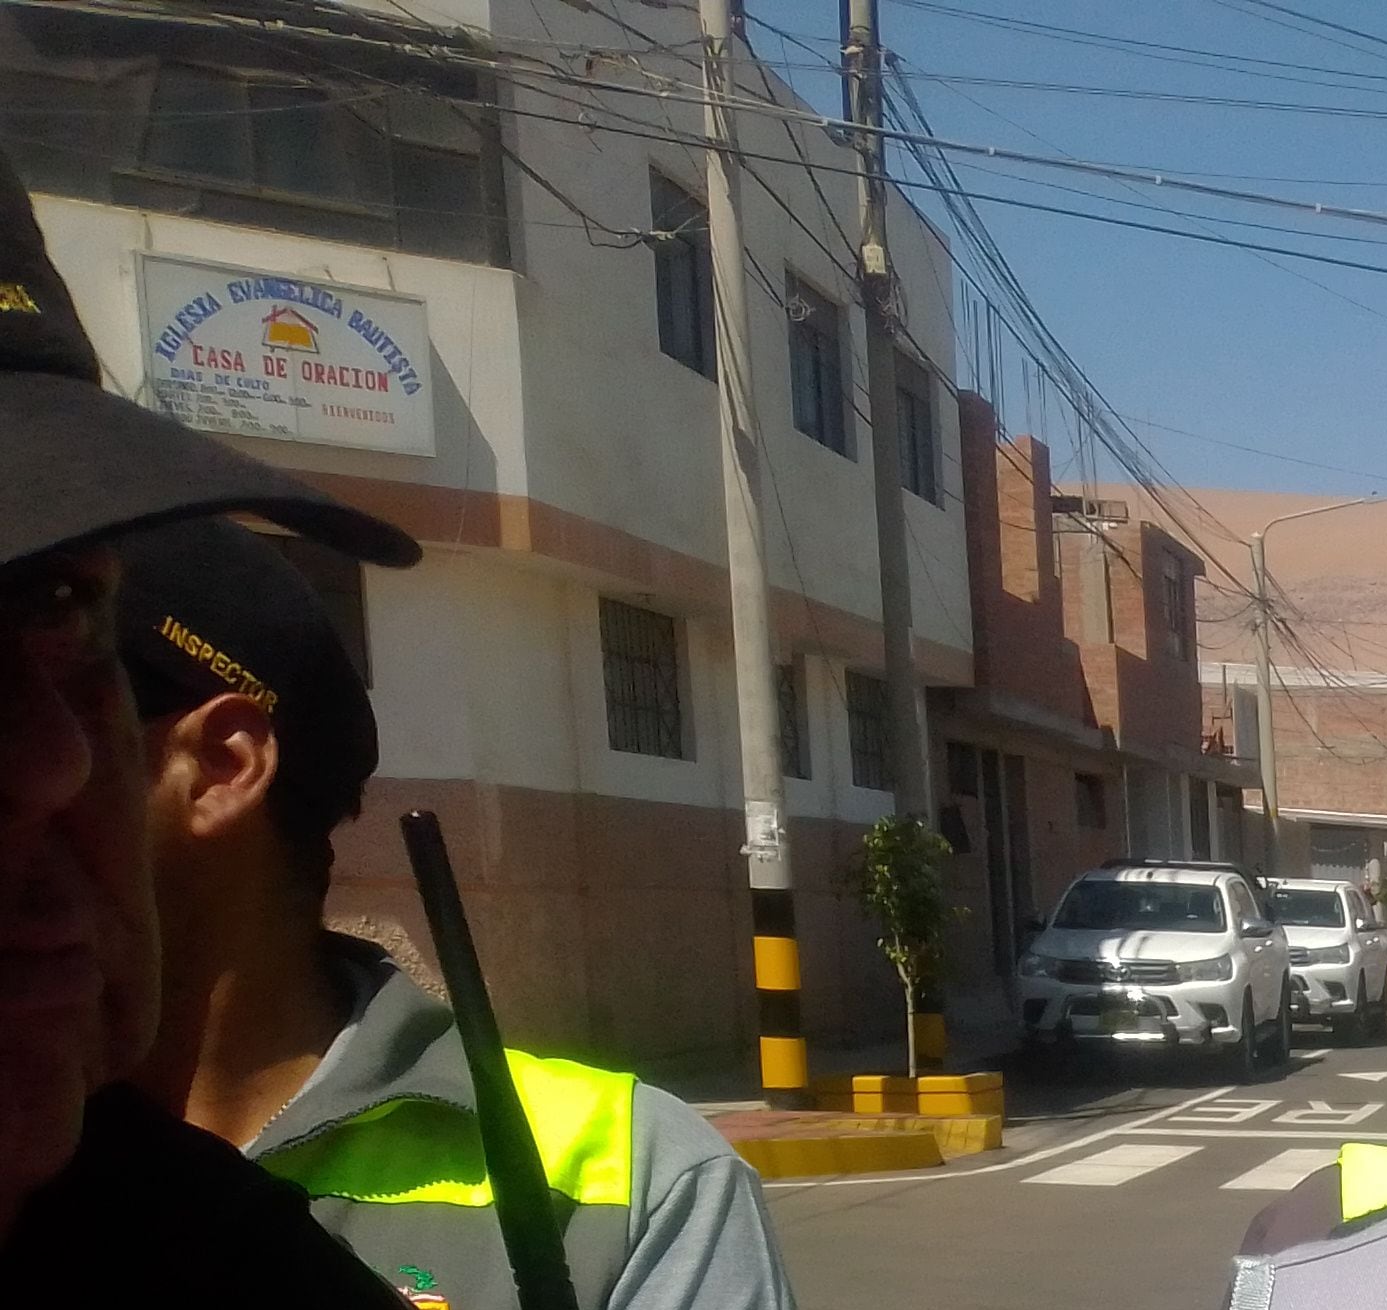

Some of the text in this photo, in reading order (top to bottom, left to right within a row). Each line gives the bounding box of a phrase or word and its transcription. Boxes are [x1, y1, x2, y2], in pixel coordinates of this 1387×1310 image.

[154, 291, 224, 363] IGLESIA
[346, 309, 422, 396] BAUTISTA
[191, 344, 389, 393] CASA DE ORACION
[161, 615, 279, 714] INSPECTOR
